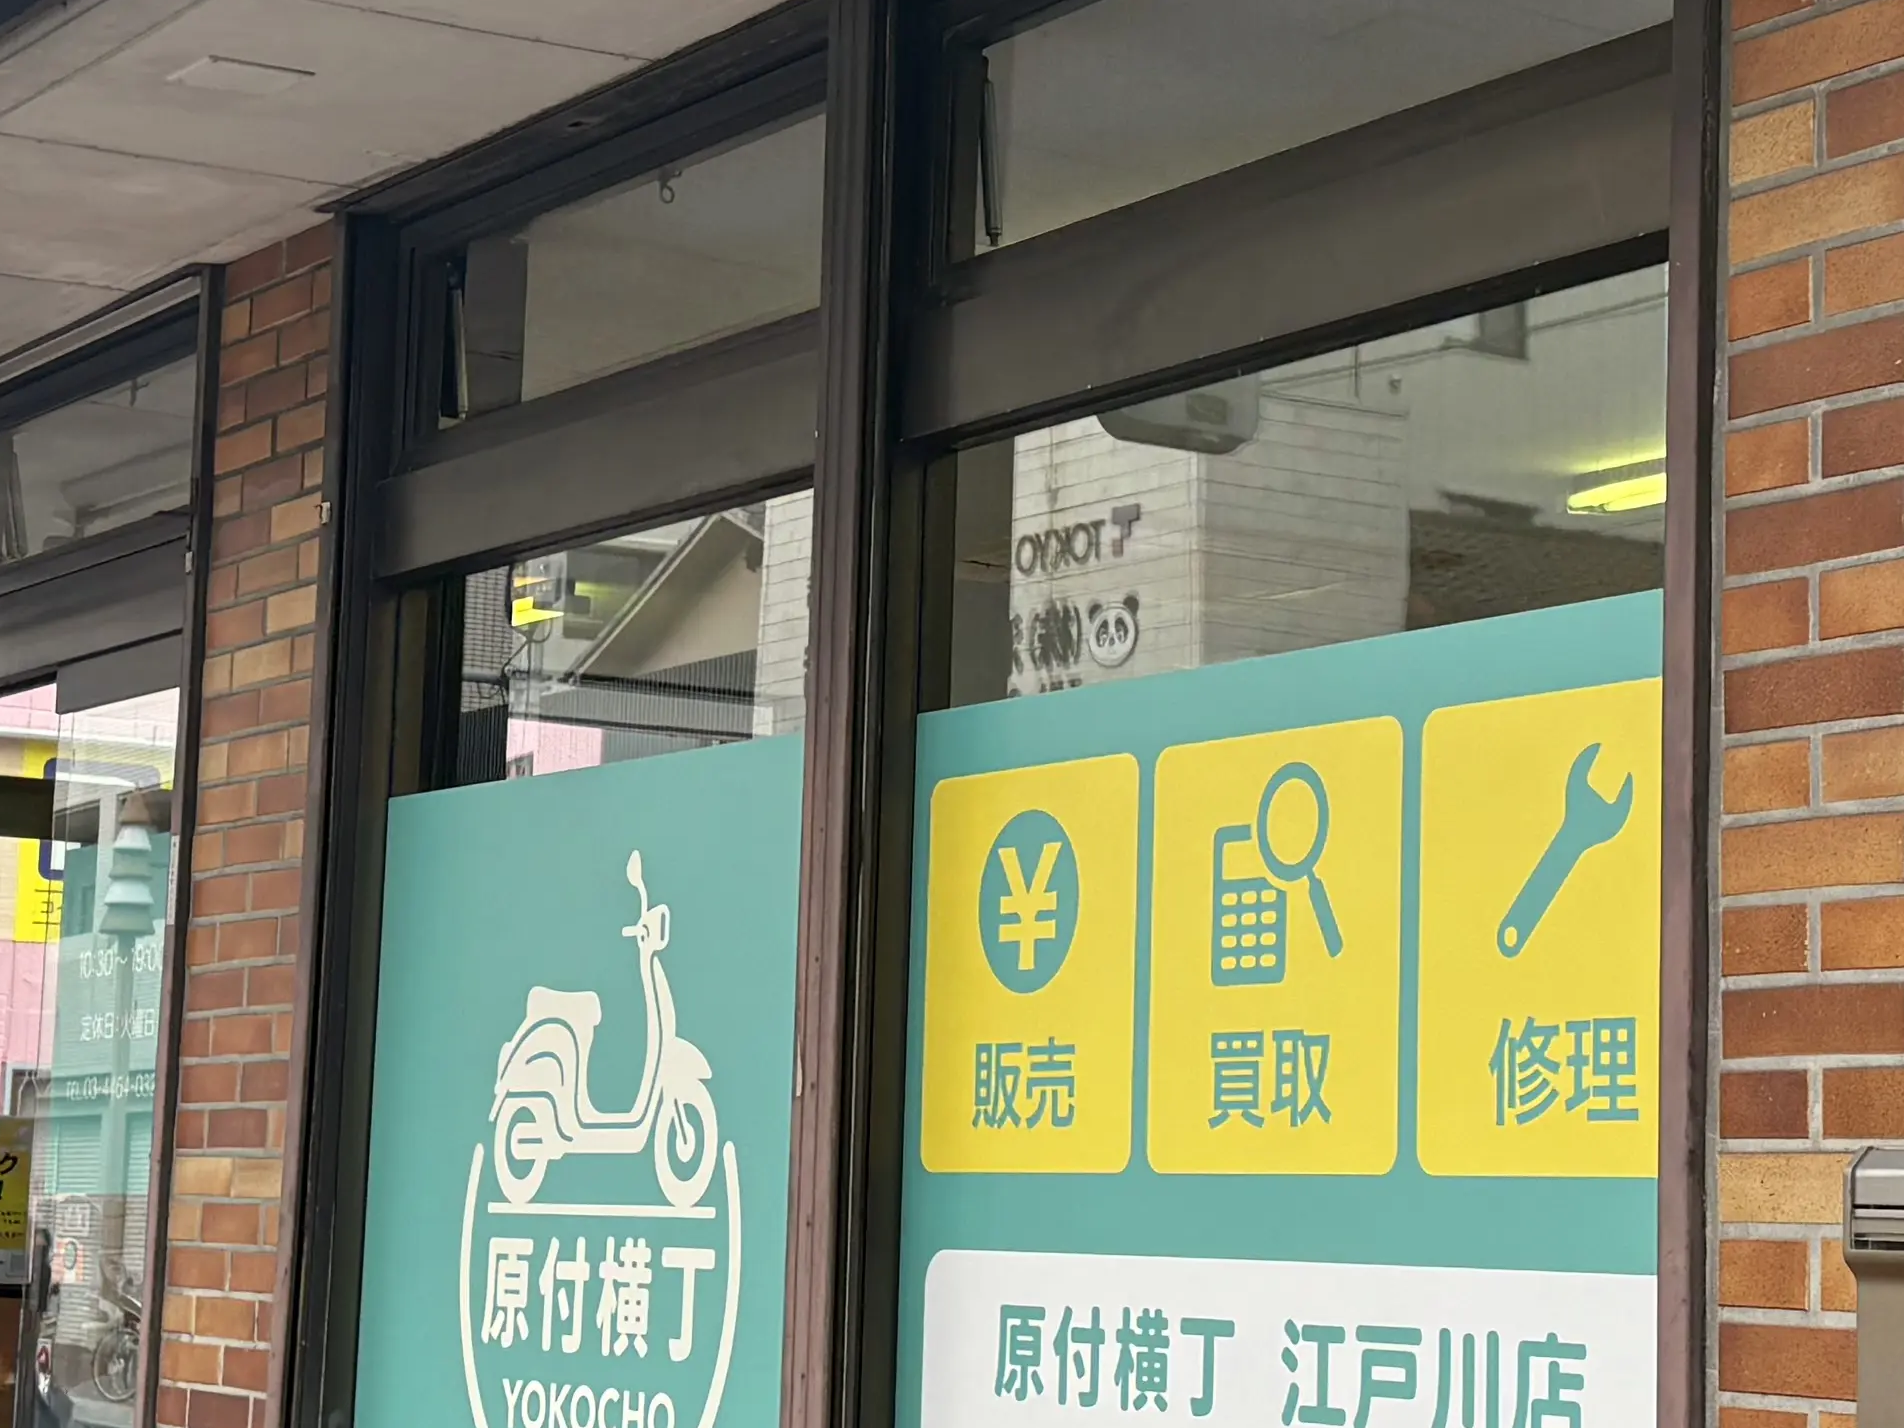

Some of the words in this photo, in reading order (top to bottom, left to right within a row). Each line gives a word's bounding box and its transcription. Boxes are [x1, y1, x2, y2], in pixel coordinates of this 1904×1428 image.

[971, 1036, 1077, 1131] 販売
[1207, 1028, 1332, 1129] 買取
[1488, 1016, 1641, 1127] 修理
[480, 1234, 716, 1362] 原付横丁
[993, 1303, 1236, 1418] 原付横丁
